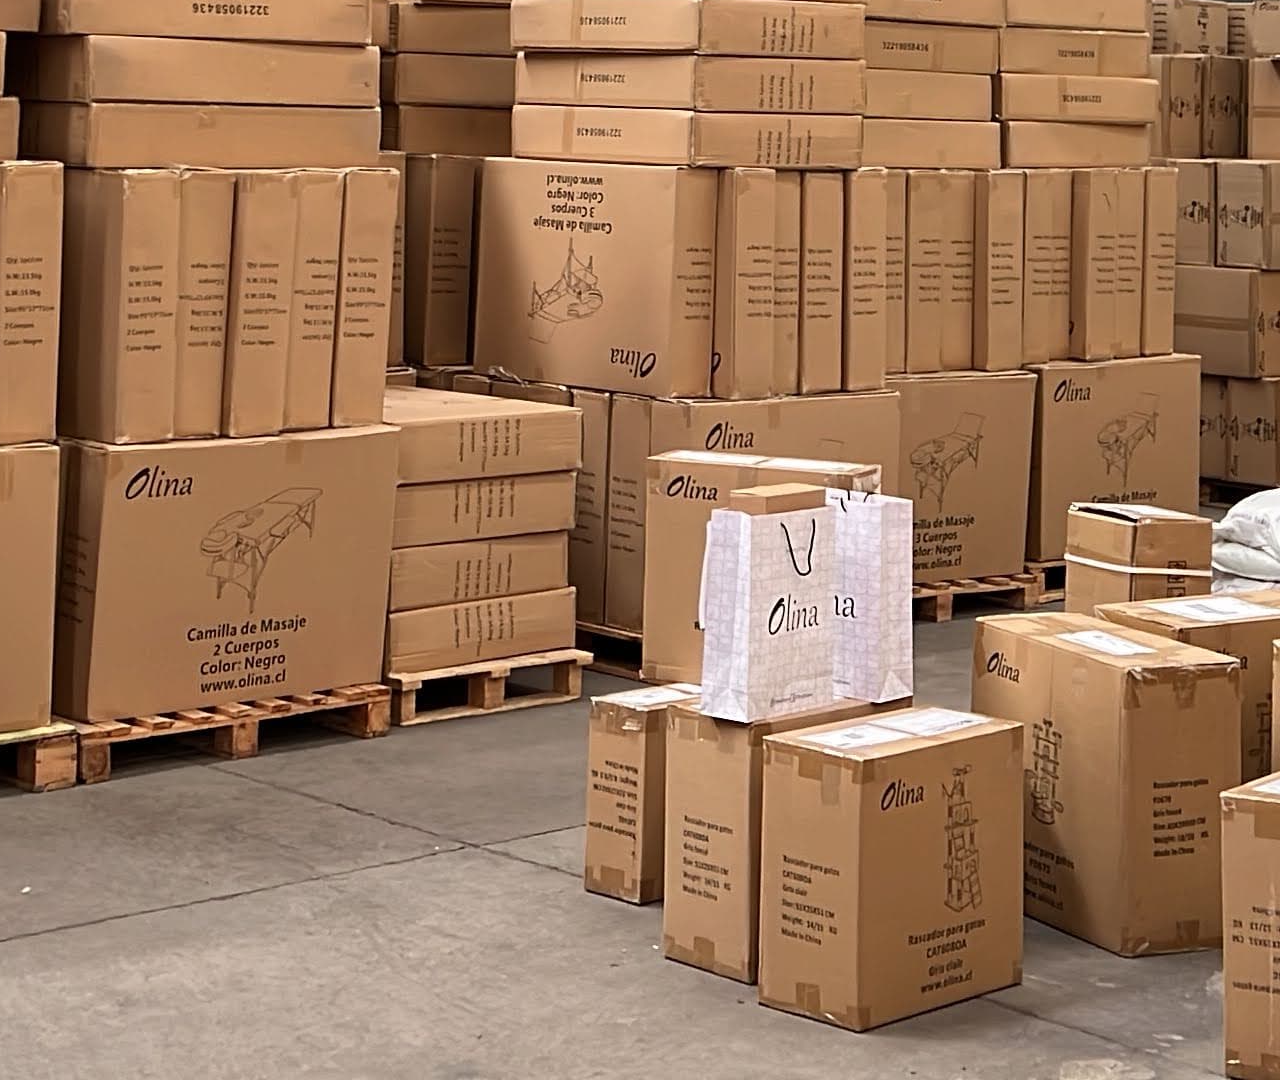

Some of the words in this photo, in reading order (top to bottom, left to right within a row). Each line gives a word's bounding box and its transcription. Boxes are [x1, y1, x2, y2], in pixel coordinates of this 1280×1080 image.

[192, 3, 269, 16] 32219058436
[546, 174, 603, 187] www.olina.cl
[547, 189, 575, 201] Negro
[575, 191, 604, 204] Color:
[551, 204, 588, 218] Cuerpos
[533, 217, 564, 232] Masaje
[566, 220, 579, 231] de
[579, 221, 612, 234] Camilla
[610, 348, 656, 379] Olina
[1054, 379, 1091, 403] Olina
[706, 422, 754, 450] Olina
[125, 466, 193, 500] Olina
[666, 474, 718, 501] Olina
[923, 532, 958, 545] Cuerpos
[935, 544, 962, 556] Negro
[768, 593, 820, 635] Olina
[186, 624, 237, 643] Camilla
[240, 621, 257, 638] de
[260, 614, 307, 634] Masaje
[213, 644, 221, 657] 2
[224, 636, 280, 658] Cuerpos
[200, 658, 240, 677] Color:
[244, 651, 287, 672] Negro
[986, 651, 1020, 685] Olina
[200, 669, 287, 694] www.olina.cl
[880, 781, 925, 812] Olina
